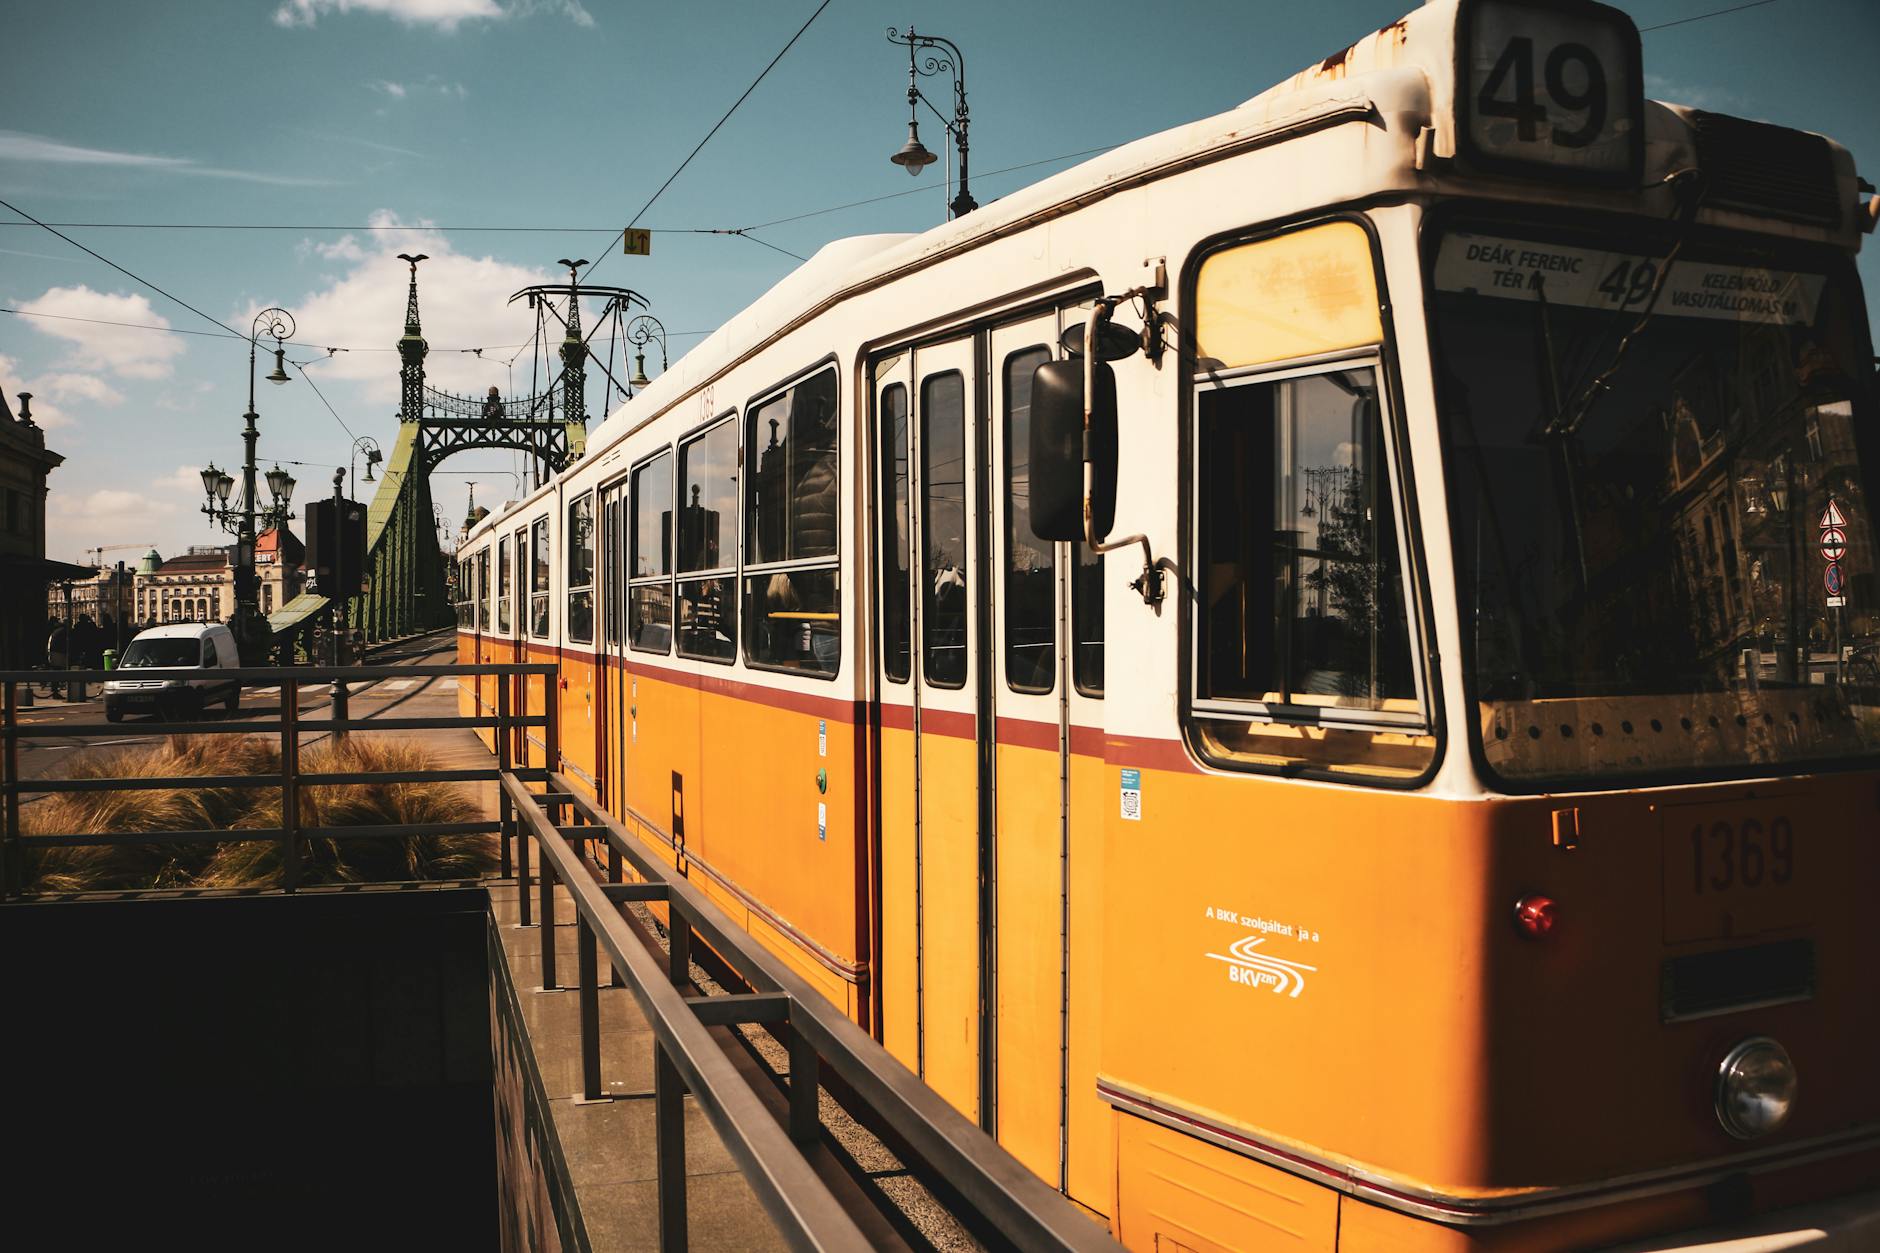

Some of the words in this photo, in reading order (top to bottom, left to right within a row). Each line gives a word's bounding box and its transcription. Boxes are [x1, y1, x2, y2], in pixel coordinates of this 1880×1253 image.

[1478, 36, 1607, 149] 49
[1466, 244, 1515, 265] DEÁK
[1518, 251, 1583, 273] FERENC
[1493, 268, 1524, 288] TÉR
[1599, 260, 1658, 304] 49
[1690, 816, 1793, 895] 1369
[1206, 906, 1214, 918] A
[1217, 908, 1238, 923] BKK
[1312, 932, 1319, 942] a
